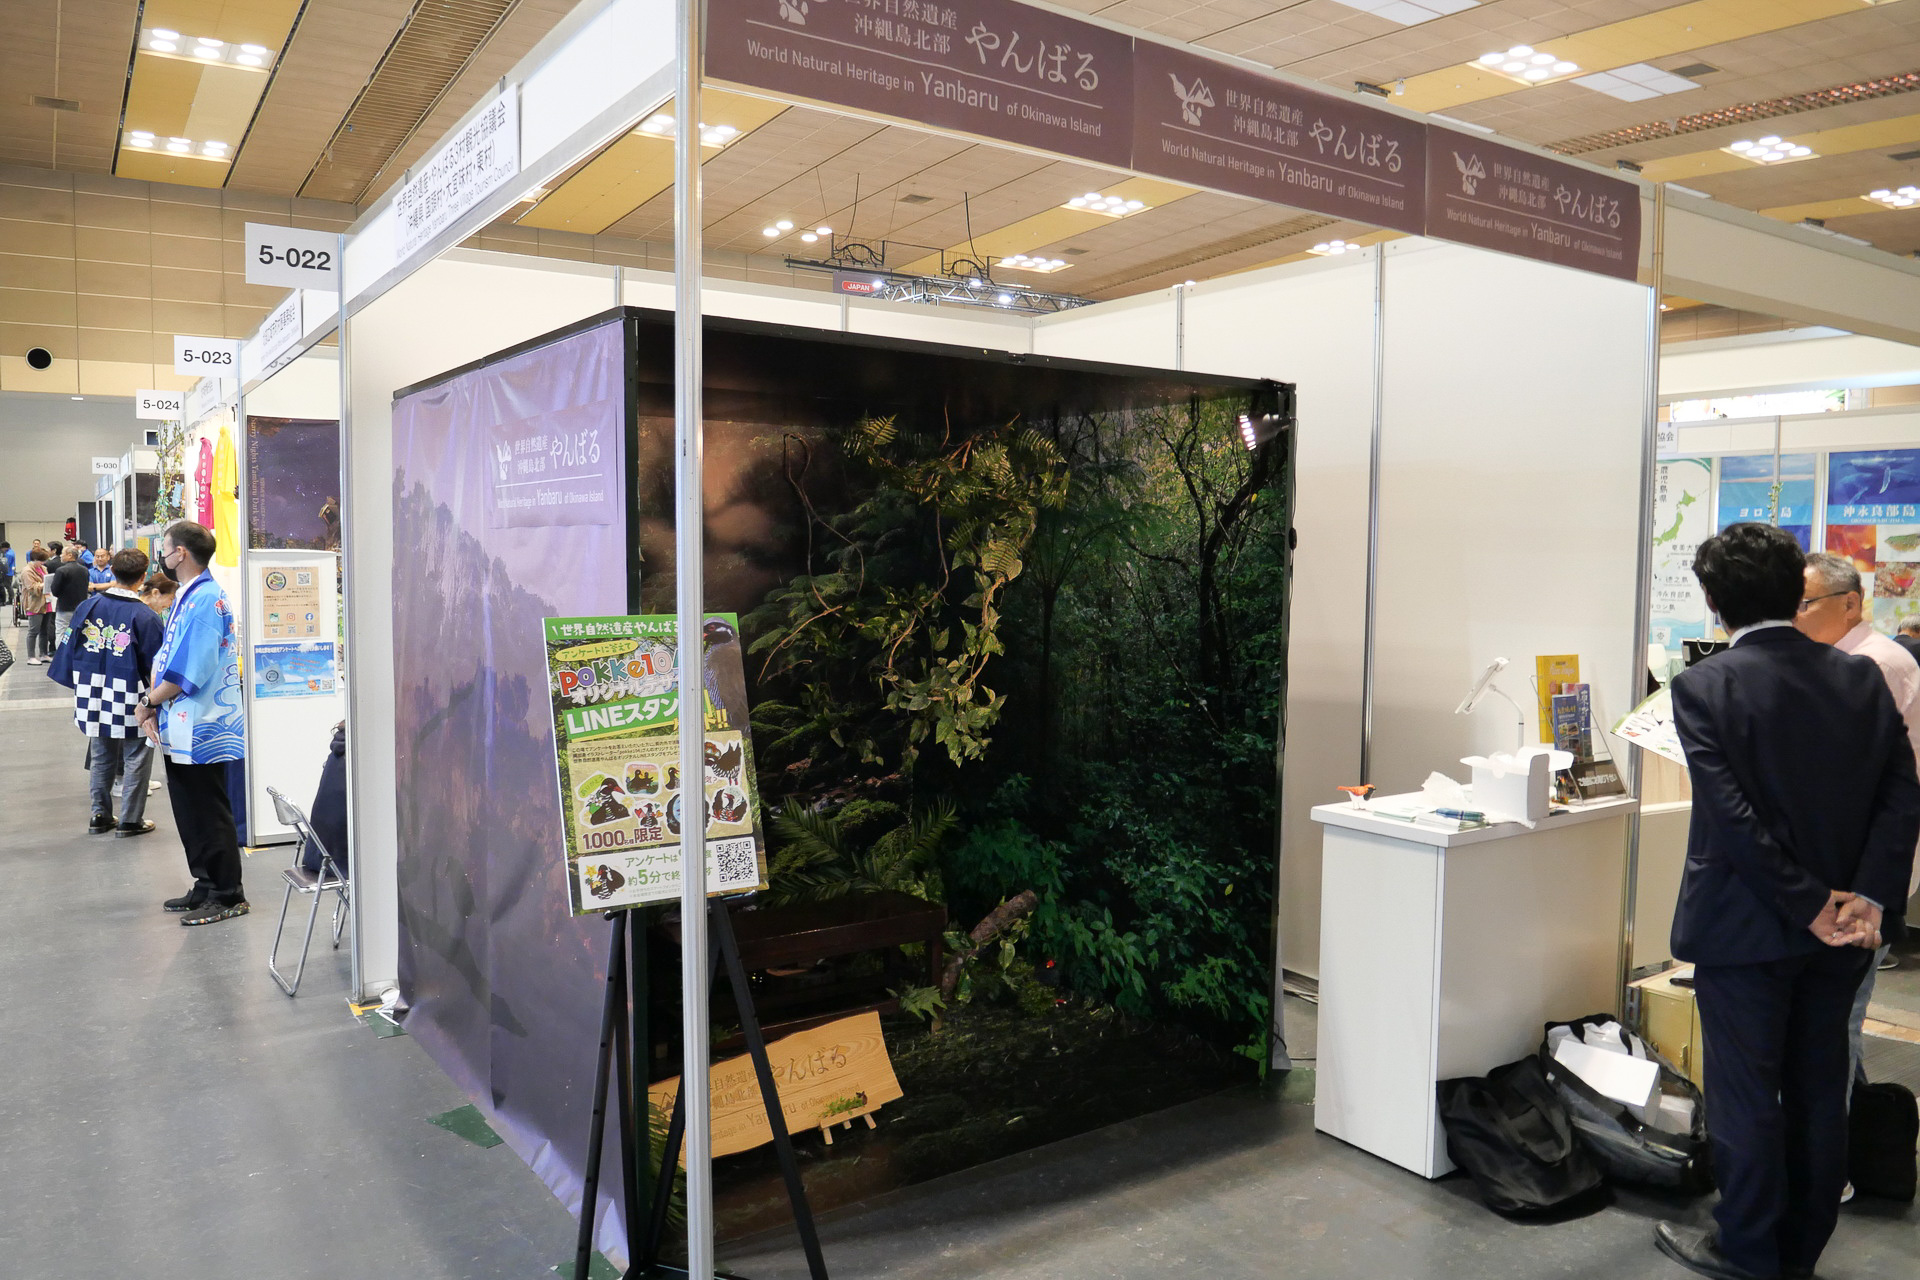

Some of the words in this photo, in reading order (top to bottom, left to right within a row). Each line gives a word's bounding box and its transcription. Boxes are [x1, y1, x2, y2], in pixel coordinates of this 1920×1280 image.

[845, 0, 957, 30] 界自然遺産
[854, 13, 951, 55] 沖縄島北部
[965, 21, 1099, 91] やんばる
[747, 39, 788, 63] World
[792, 50, 842, 75] Natural
[847, 62, 899, 90] Heritage
[904, 76, 915, 92] in
[921, 72, 999, 111] Yanbaru
[1007, 102, 1018, 116] of
[1021, 104, 1067, 129] Okinawa
[1070, 117, 1101, 136] Island
[1226, 89, 1303, 126] 世界自然遺産
[1233, 116, 1299, 147] 沖縄島北部
[1309, 117, 1402, 173] やんばる
[493, 156, 514, 184] Council
[1161, 138, 1189, 158] World
[1191, 147, 1225, 167] Natural
[1228, 156, 1265, 177] Heritage
[1267, 165, 1275, 179] in
[1278, 162, 1333, 192] Yanbaru
[1338, 184, 1346, 195] of
[1348, 186, 1380, 205] Okinawa
[1382, 194, 1404, 210] Island
[1493, 162, 1550, 191] 世界自然遺産
[1499, 185, 1547, 209] 沖縄島北部
[1554, 183, 1621, 229] やんばる
[1447, 208, 1466, 223] World
[1468, 214, 1493, 228] Natural
[1495, 219, 1521, 237] Heritage
[1531, 222, 1571, 246] Yanbaru
[1574, 240, 1580, 250] of
[1606, 247, 1622, 260] Island
[258, 245, 332, 271] 5-022
[847, 283, 871, 291] JAPAN
[183, 349, 232, 365] 5-023
[143, 399, 180, 411] 5-024
[514, 435, 549, 456] 世界自然遺産
[550, 428, 601, 469] やんばる
[537, 489, 563, 506] Yanbaru
[569, 492, 589, 504] Okinawa
[1843, 504, 1916, 517] 沖永良部島
[562, 642, 631, 659] アンケートに答えて
[570, 674, 679, 705] オリジナルデザ
[625, 850, 681, 869] アンケートは
[711, 1070, 758, 1090] 自然遺産
